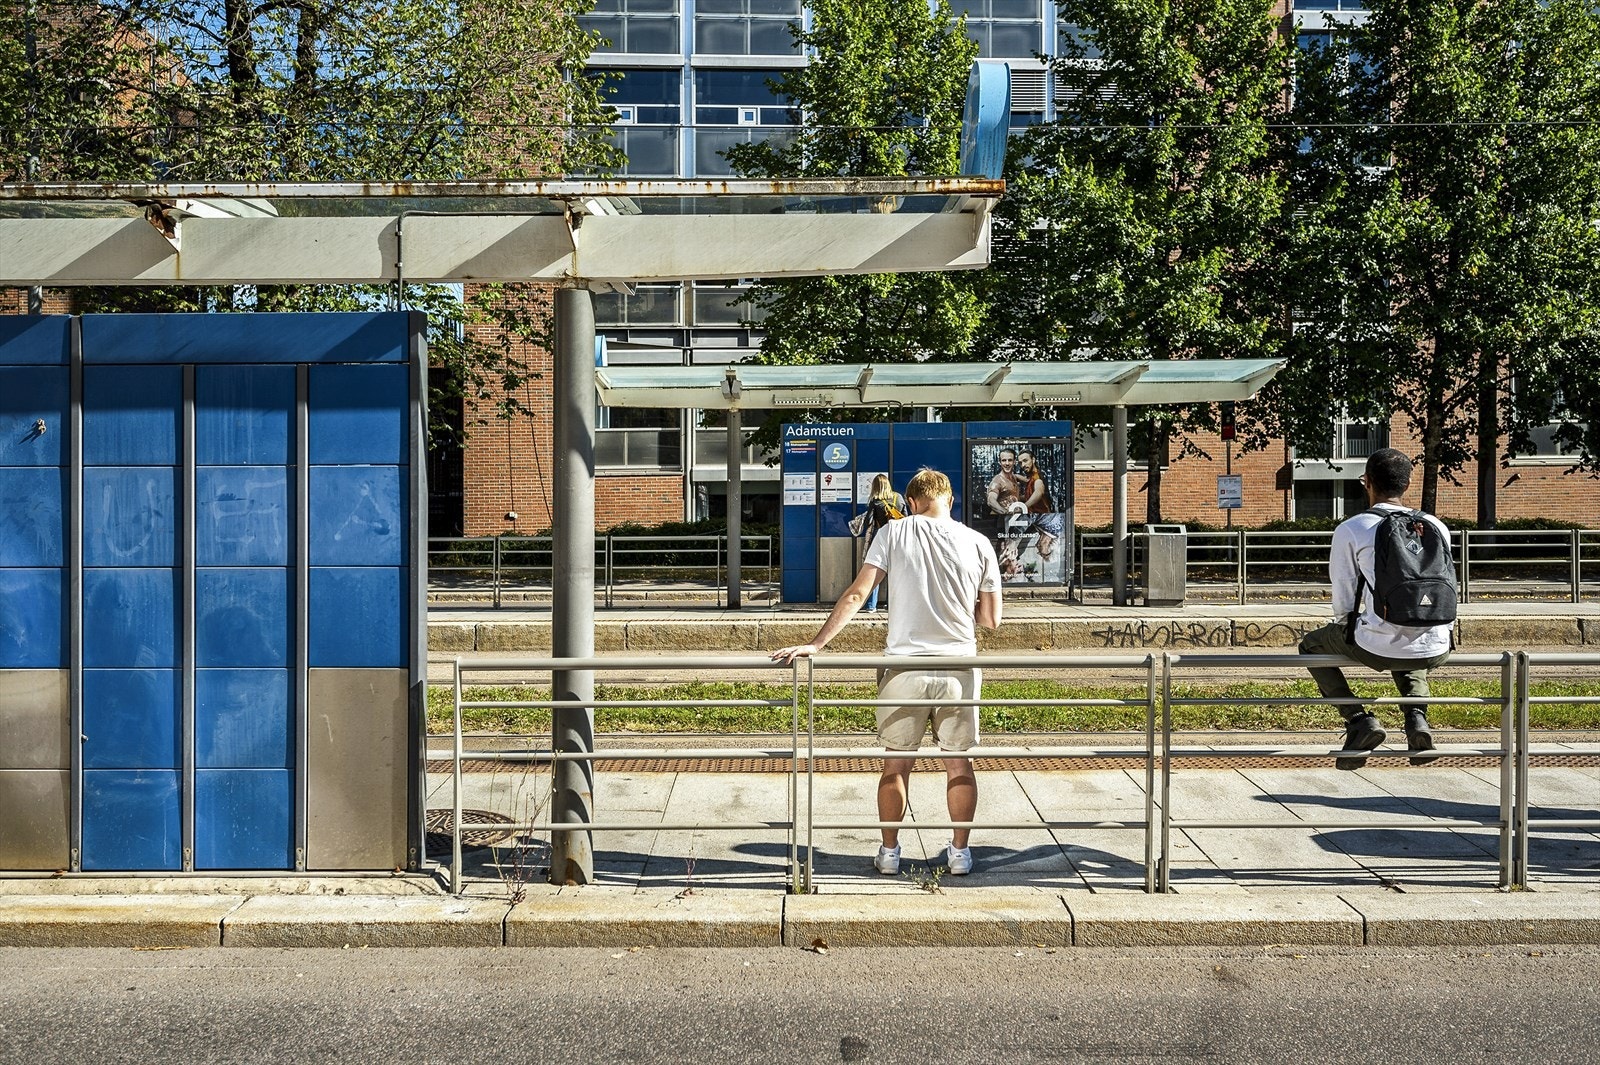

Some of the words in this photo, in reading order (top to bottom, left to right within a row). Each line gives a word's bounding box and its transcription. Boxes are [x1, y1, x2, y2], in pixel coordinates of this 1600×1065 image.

[786, 424, 854, 436] Adamstuen
[831, 447, 842, 460] 5
[1008, 501, 1029, 527] 2
